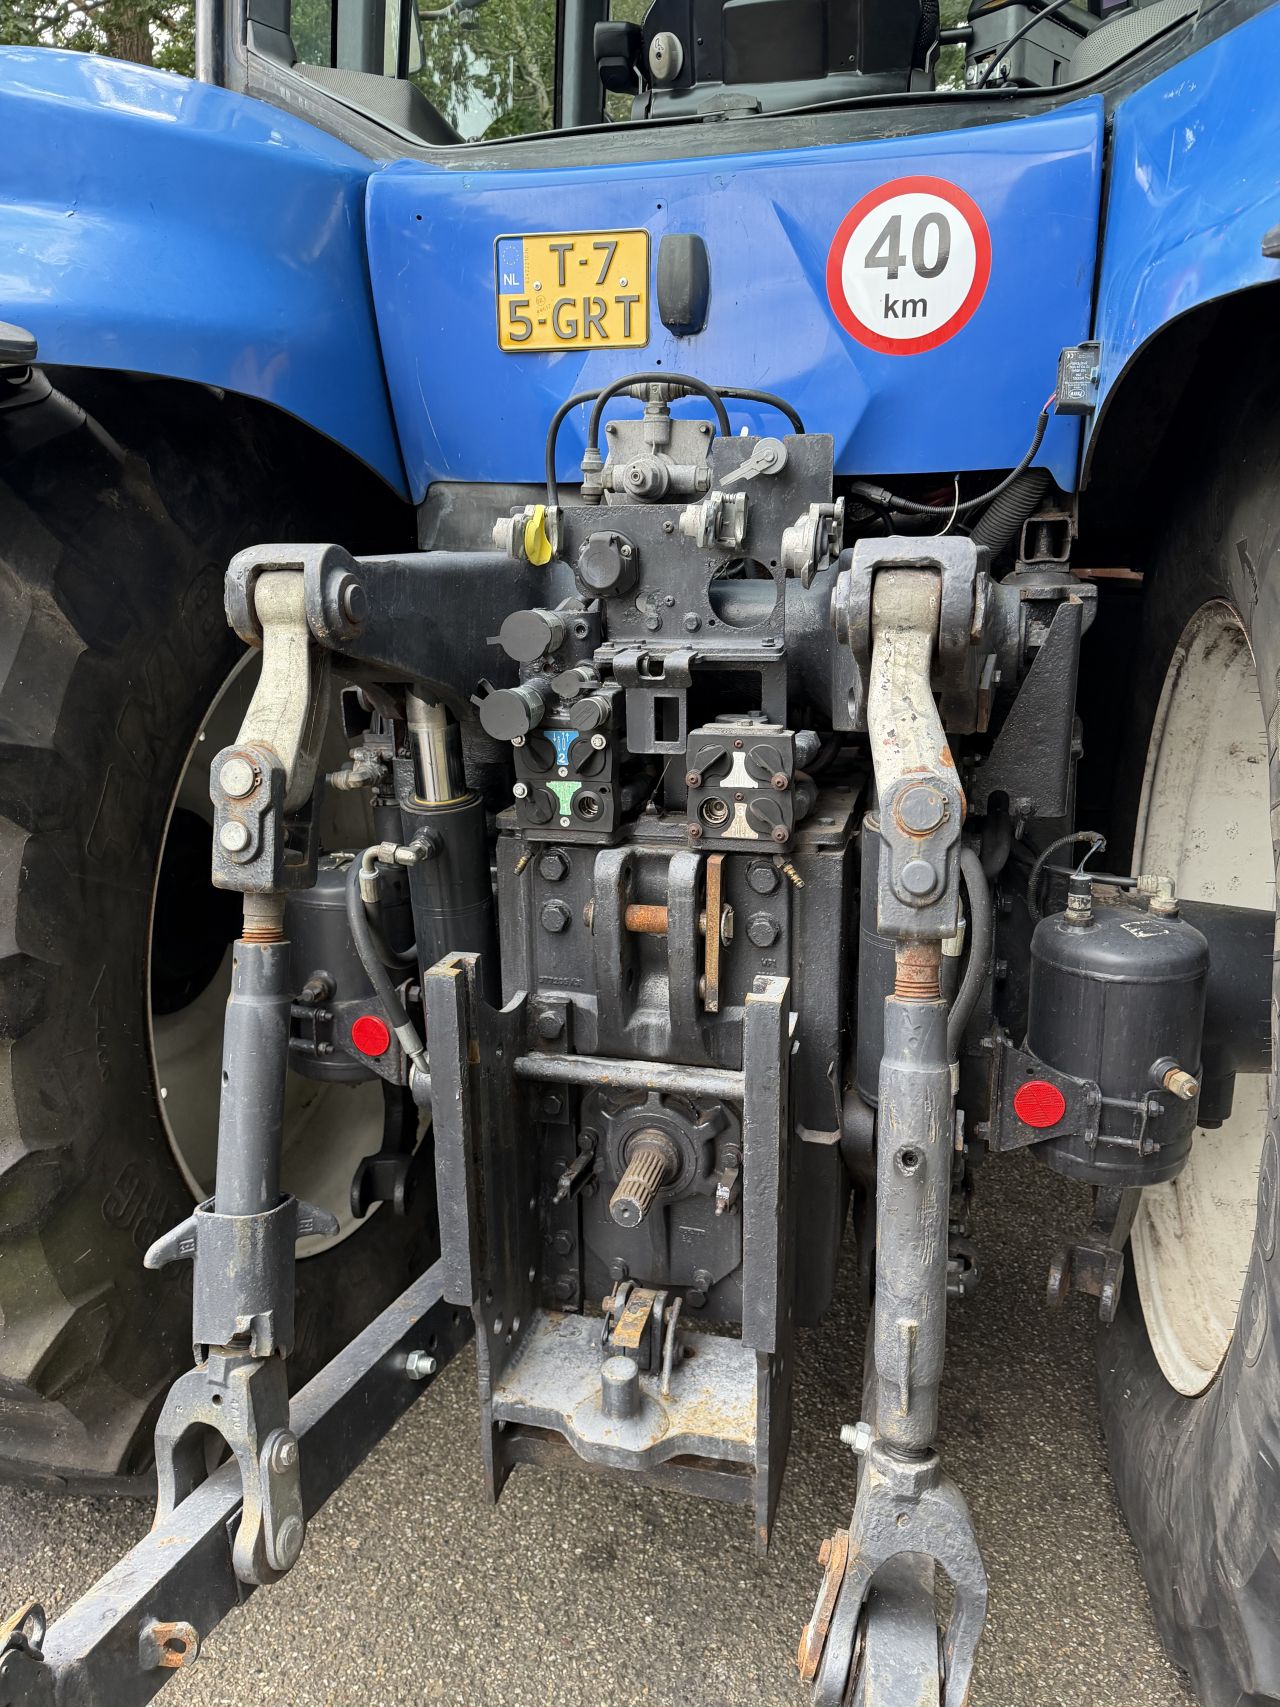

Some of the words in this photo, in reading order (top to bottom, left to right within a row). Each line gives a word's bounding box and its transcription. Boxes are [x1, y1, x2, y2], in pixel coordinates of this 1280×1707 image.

[549, 240, 618, 286] T-7
[864, 212, 951, 280] 40
[503, 273, 520, 286] NL
[509, 294, 640, 342] 5-GRT
[884, 293, 928, 319] km
[559, 753, 565, 763] 2
